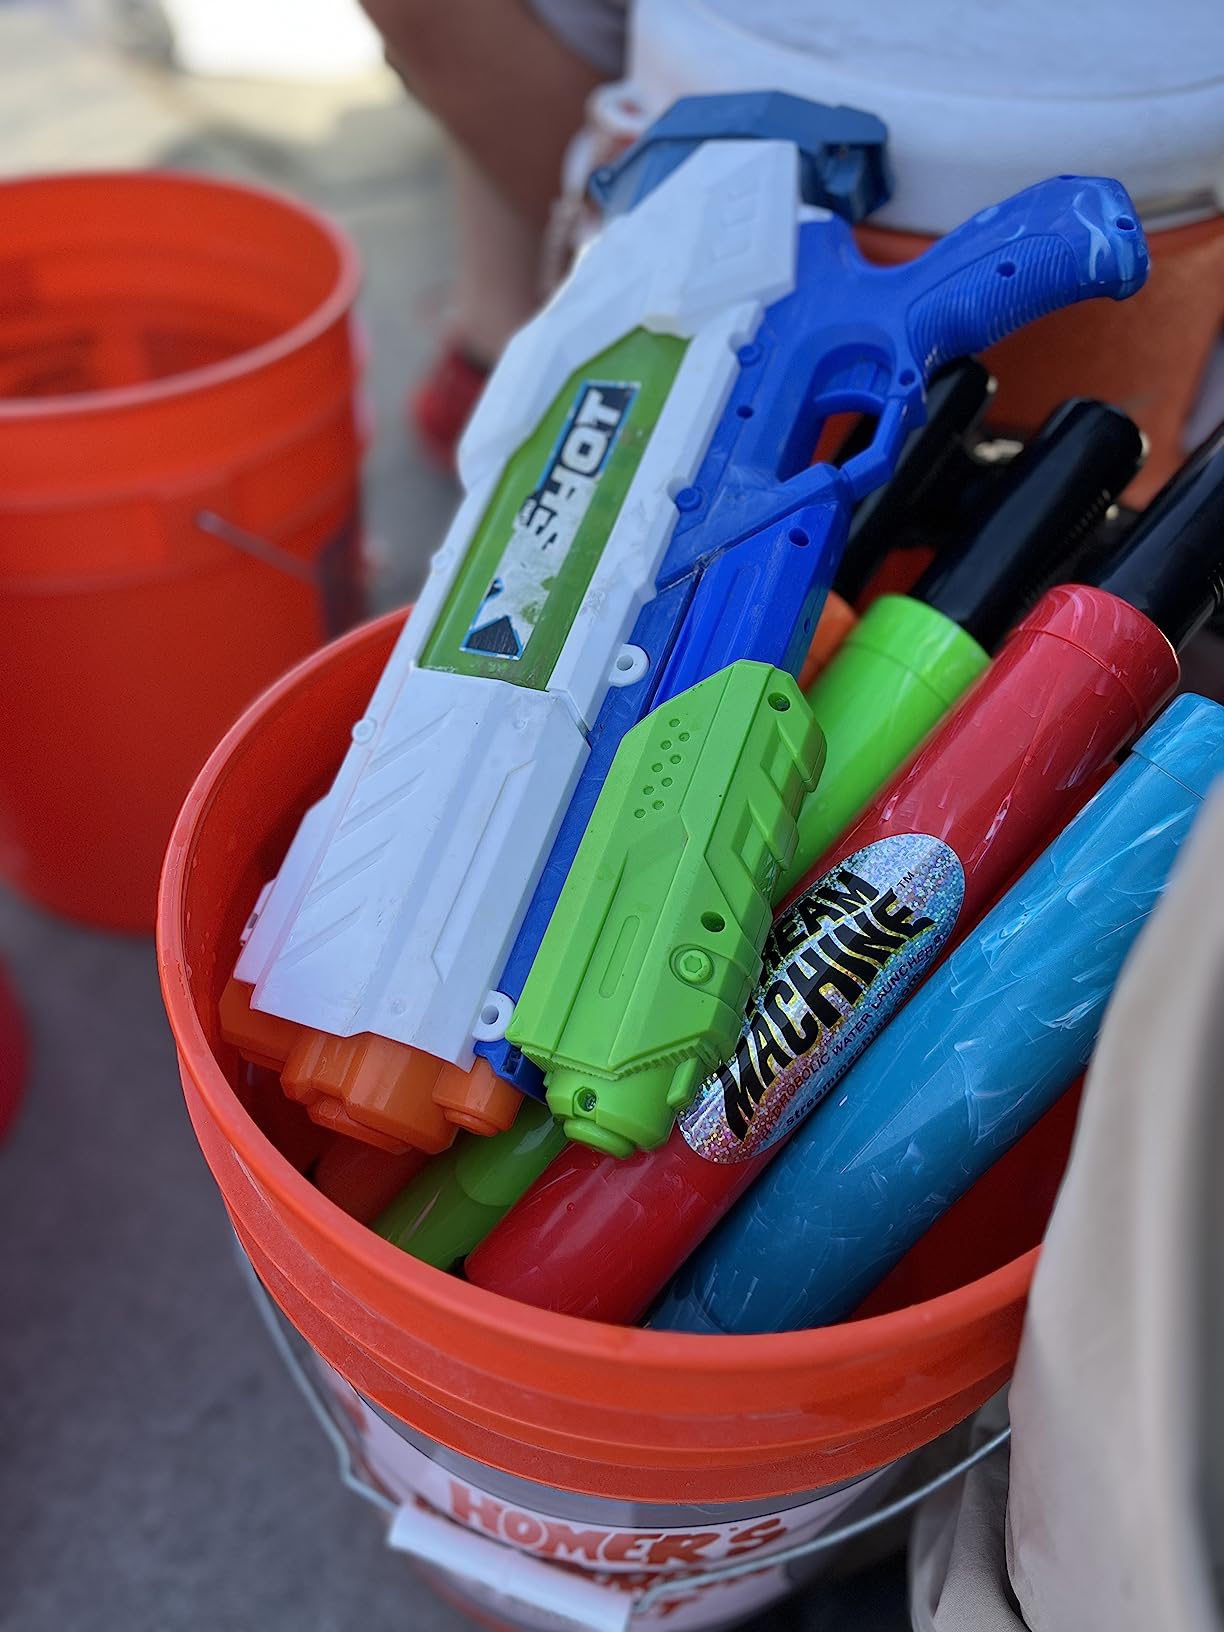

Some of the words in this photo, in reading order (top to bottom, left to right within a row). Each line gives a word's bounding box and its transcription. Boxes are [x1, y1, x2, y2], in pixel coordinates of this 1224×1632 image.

[717, 887, 936, 1141] MACHINE
[832, 1012, 872, 1056] WATER
[449, 1480, 787, 1565] HOMER'S
